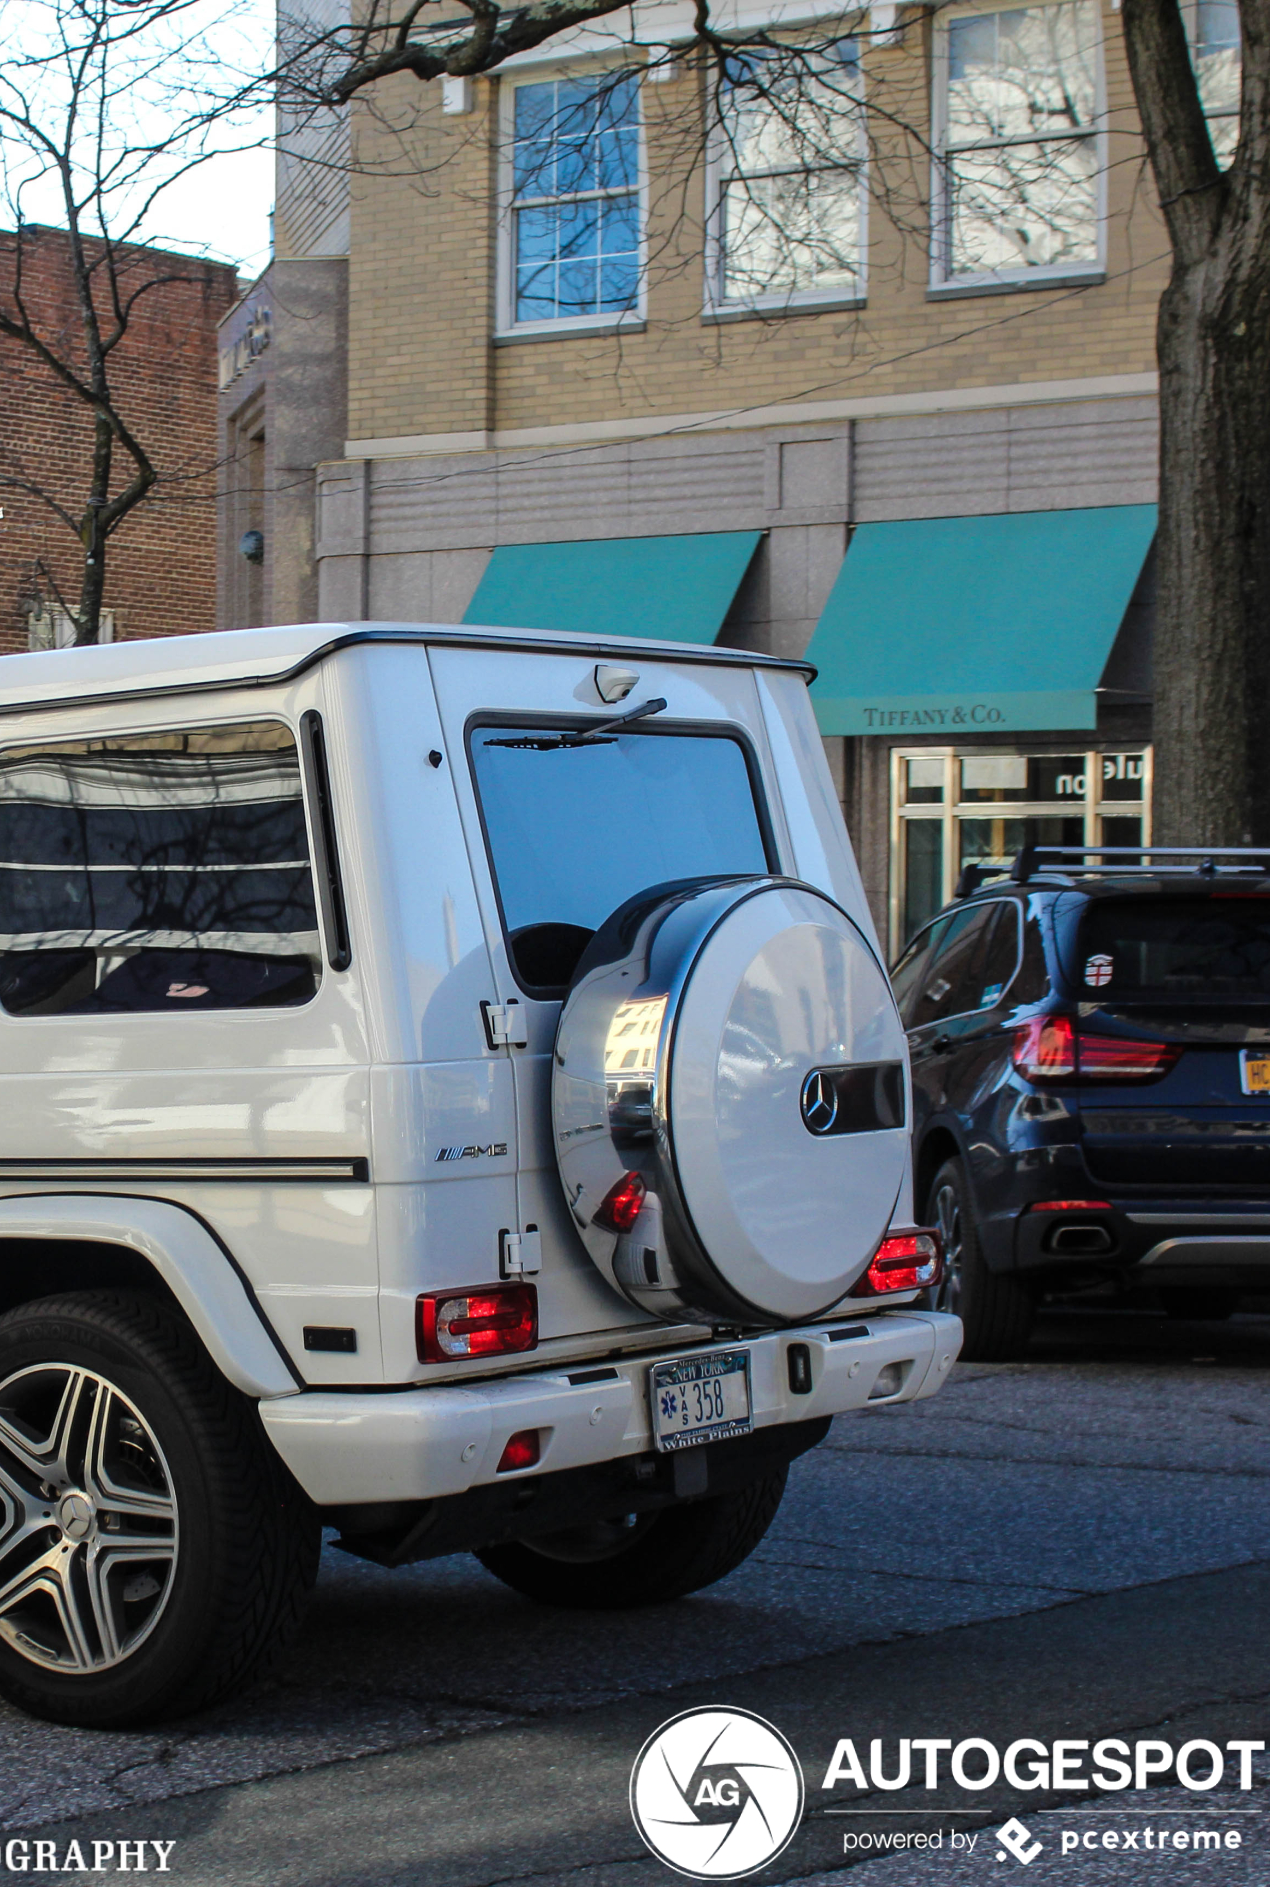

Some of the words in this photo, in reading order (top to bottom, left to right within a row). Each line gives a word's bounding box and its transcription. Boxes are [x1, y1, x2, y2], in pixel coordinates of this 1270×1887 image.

[454, 1143, 508, 1159] AMG
[675, 1364, 697, 1383] NEW
[700, 1360, 724, 1378] YORK
[693, 1378, 724, 1423] 358
[664, 1436, 704, 1451] White
[708, 1425, 750, 1441] Plains
